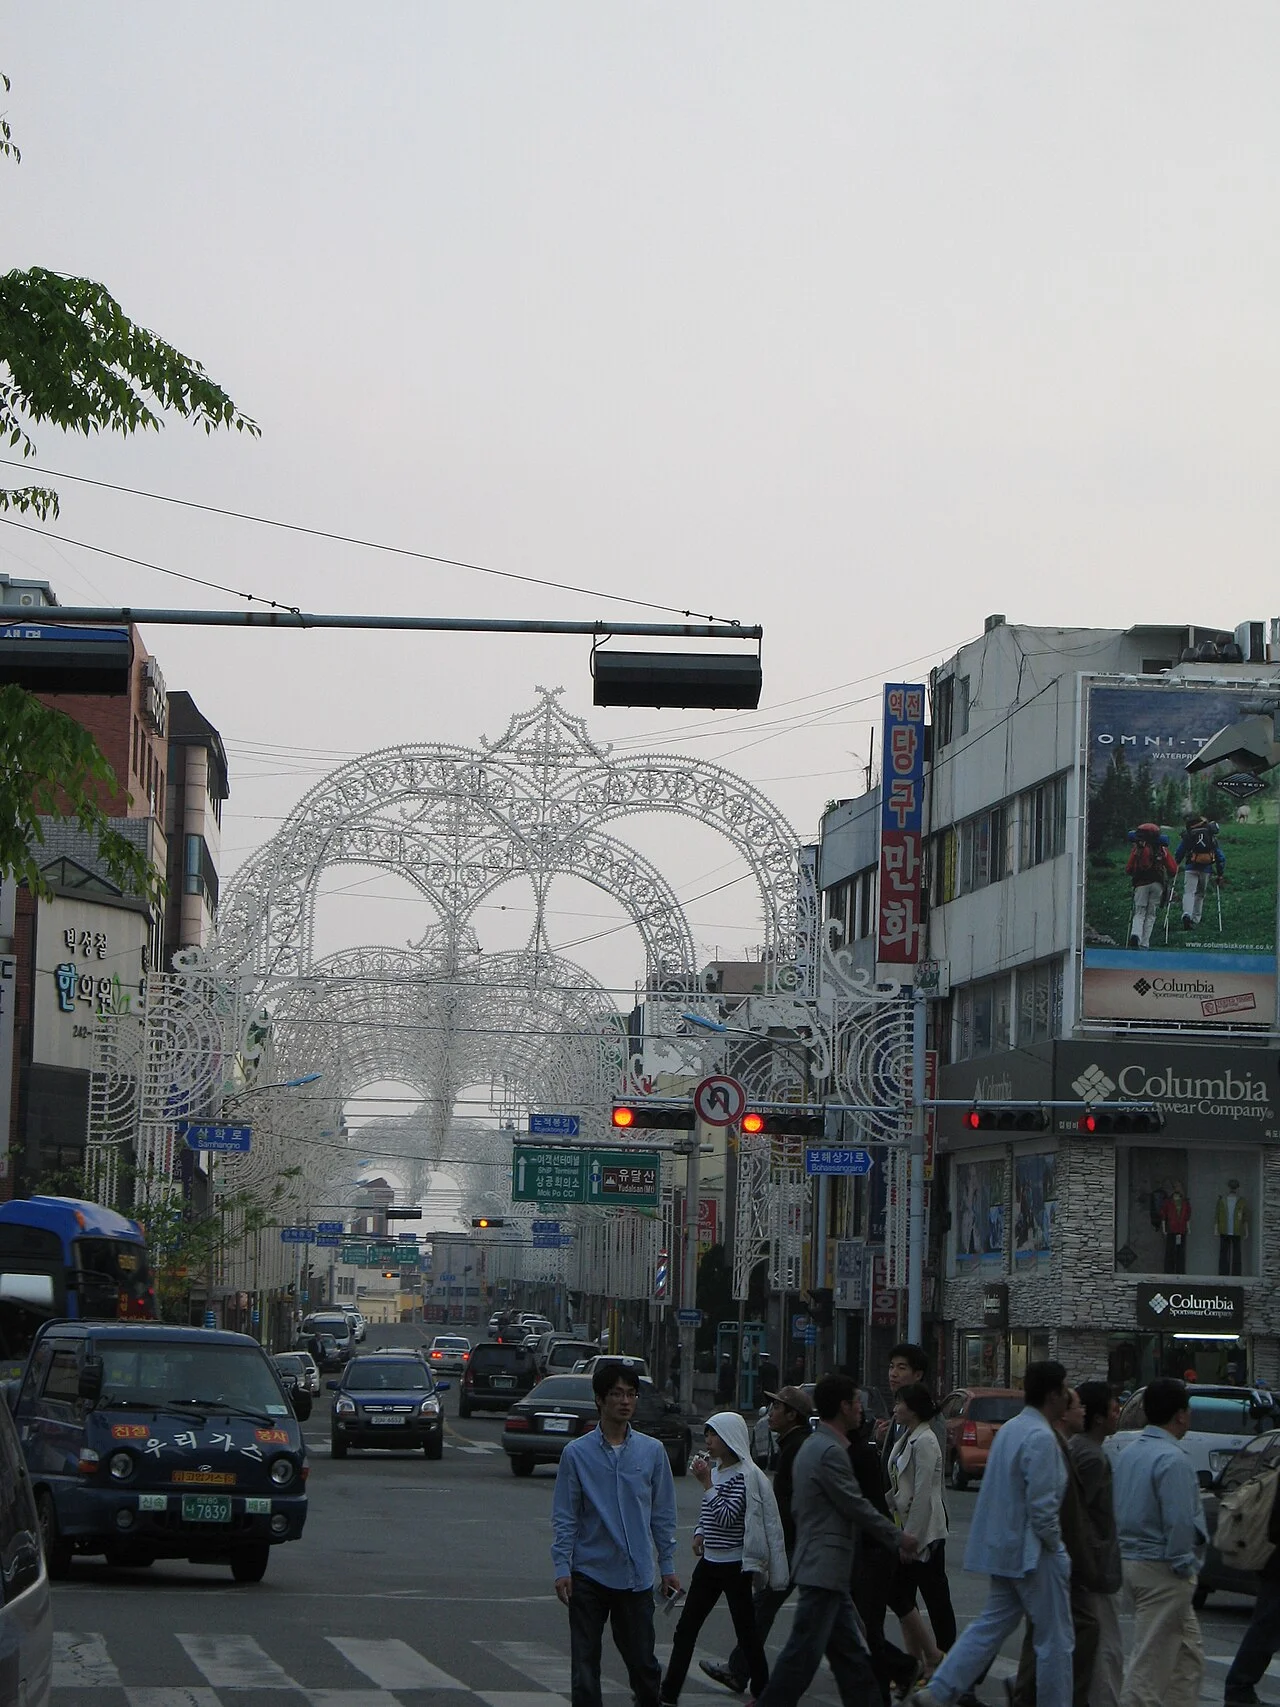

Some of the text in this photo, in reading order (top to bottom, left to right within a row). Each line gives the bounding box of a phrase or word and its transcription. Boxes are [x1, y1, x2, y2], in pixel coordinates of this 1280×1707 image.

[889, 688, 921, 721] 역전
[888, 727, 918, 829] 당구
[880, 836, 921, 956] 만화
[64, 927, 108, 959] 박성철
[55, 962, 113, 1015] 한의원
[1152, 978, 1215, 993] Columbia
[1118, 1065, 1270, 1102] Columbia
[1197, 1100, 1269, 1122] Company
[198, 1140, 240, 1150] Samhangno
[810, 1151, 865, 1164] 보해상가로
[535, 1176, 580, 1189] 상공회의소
[618, 1168, 656, 1184] 유달산
[1169, 1293, 1234, 1311] Columbia
[196, 1504, 227, 1520] 7839
